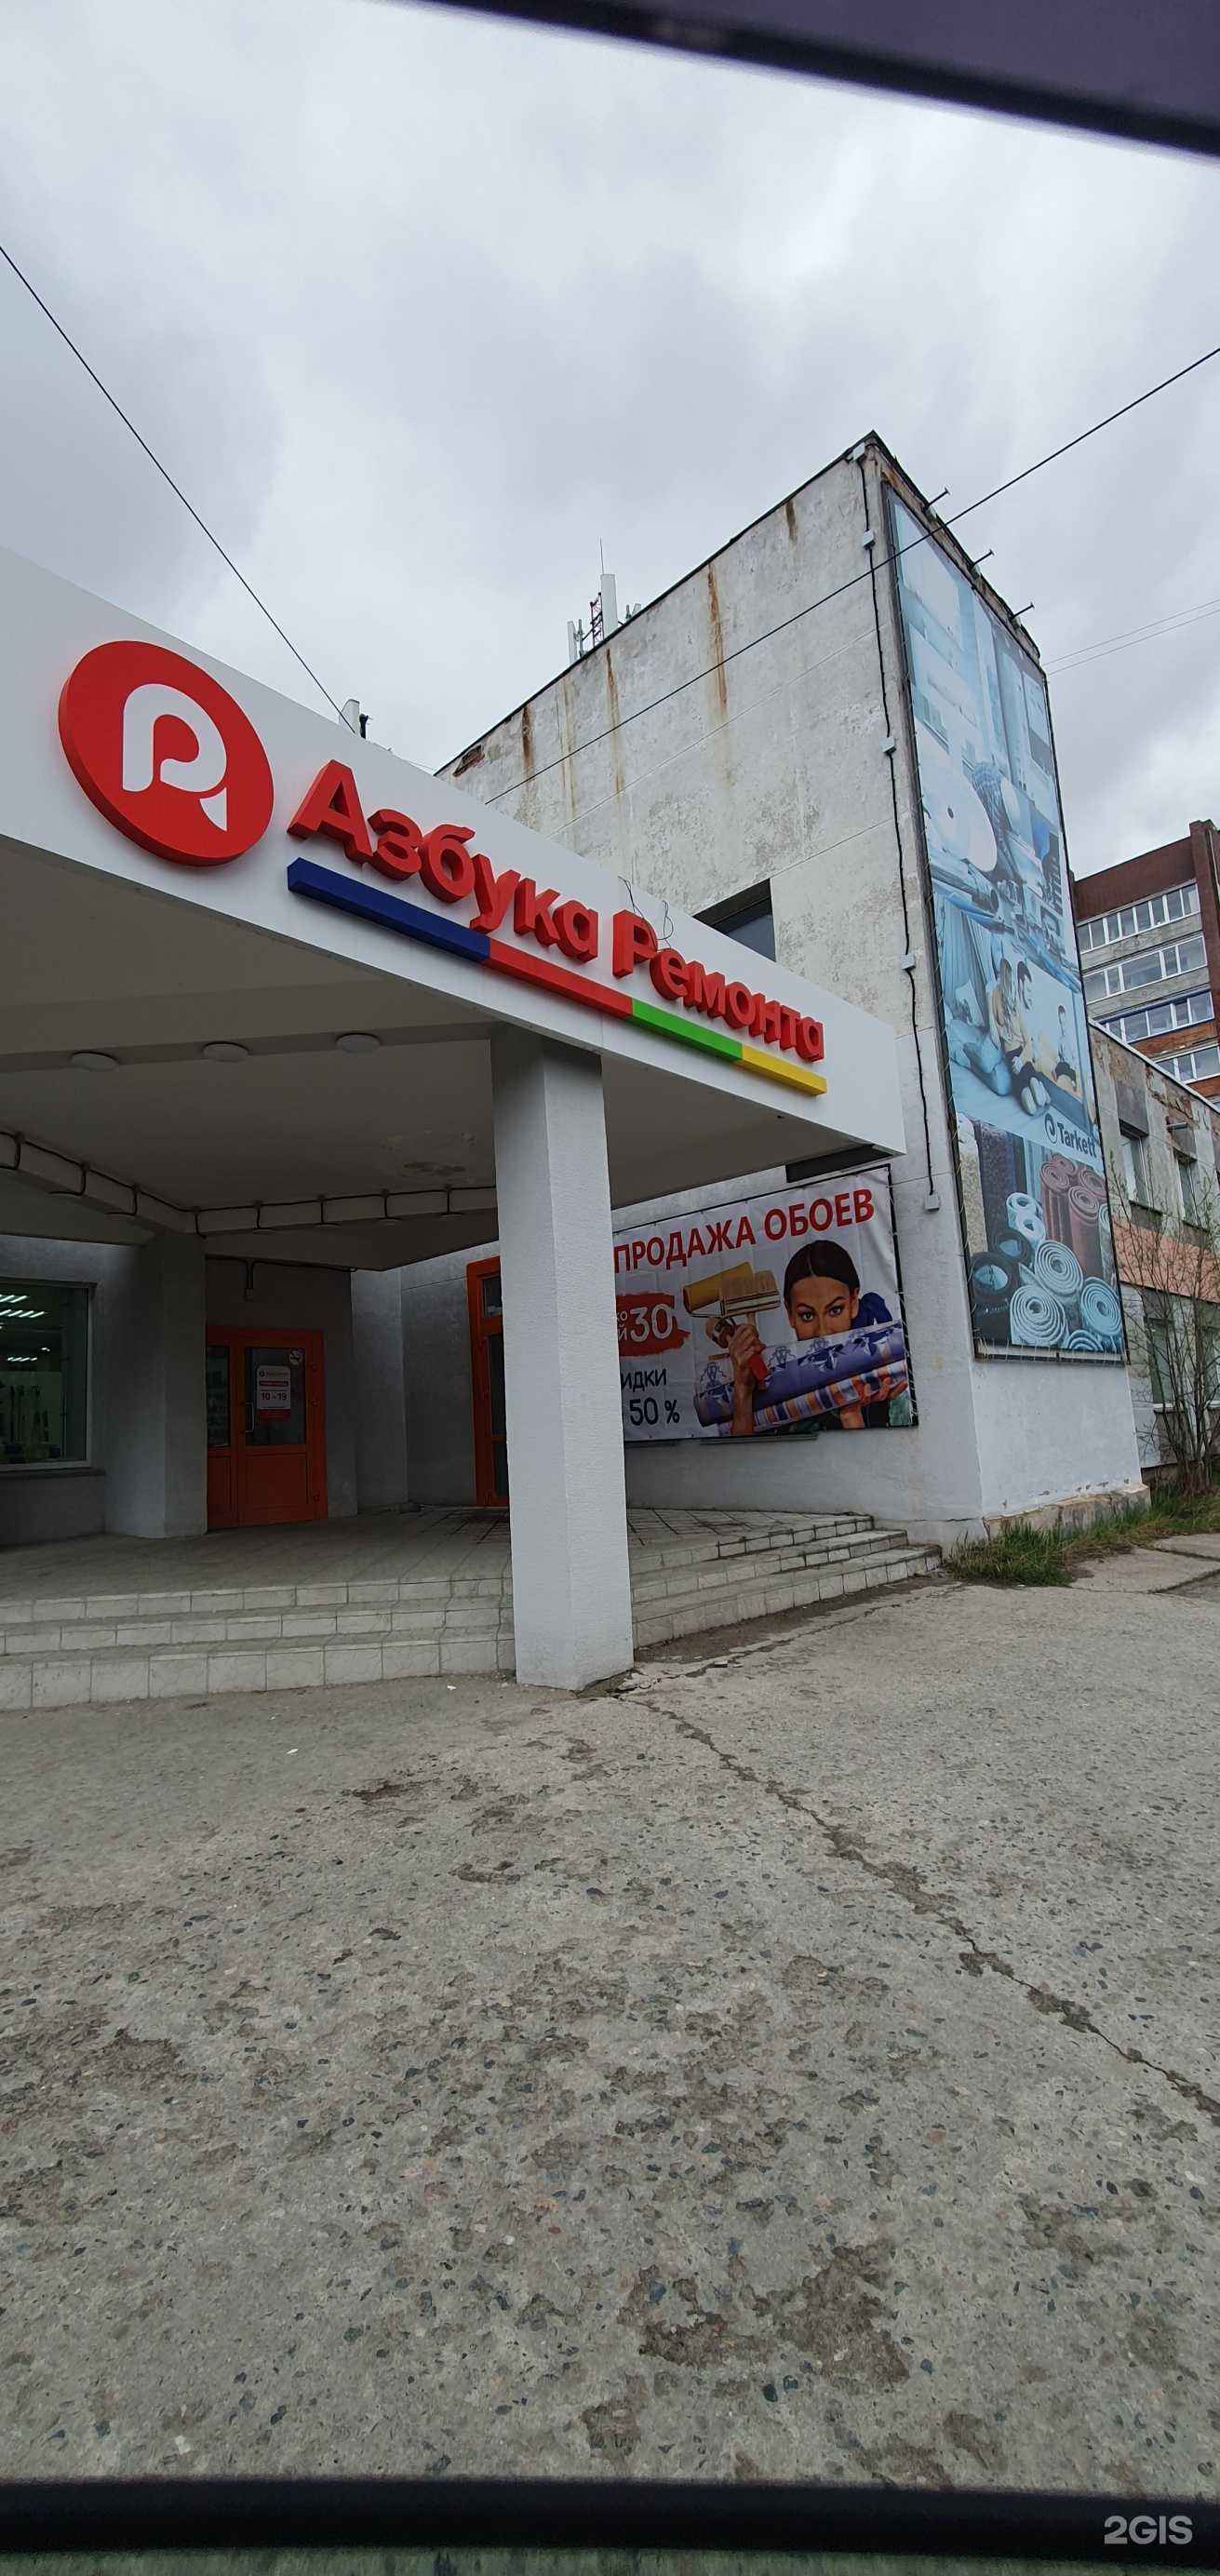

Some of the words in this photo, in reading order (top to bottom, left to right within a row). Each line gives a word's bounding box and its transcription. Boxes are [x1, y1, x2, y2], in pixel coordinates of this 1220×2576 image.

[287, 759, 598, 964] Азбука
[611, 908, 825, 1063] Ремонта
[1057, 1121, 1097, 1158] Tarkett
[613, 1215, 757, 1274] ПРОДАЖА
[763, 1188, 876, 1241] ОБОЕВ
[630, 1303, 673, 1342] 30
[629, 1398, 659, 1427] 50
[664, 1399, 680, 1424] %
